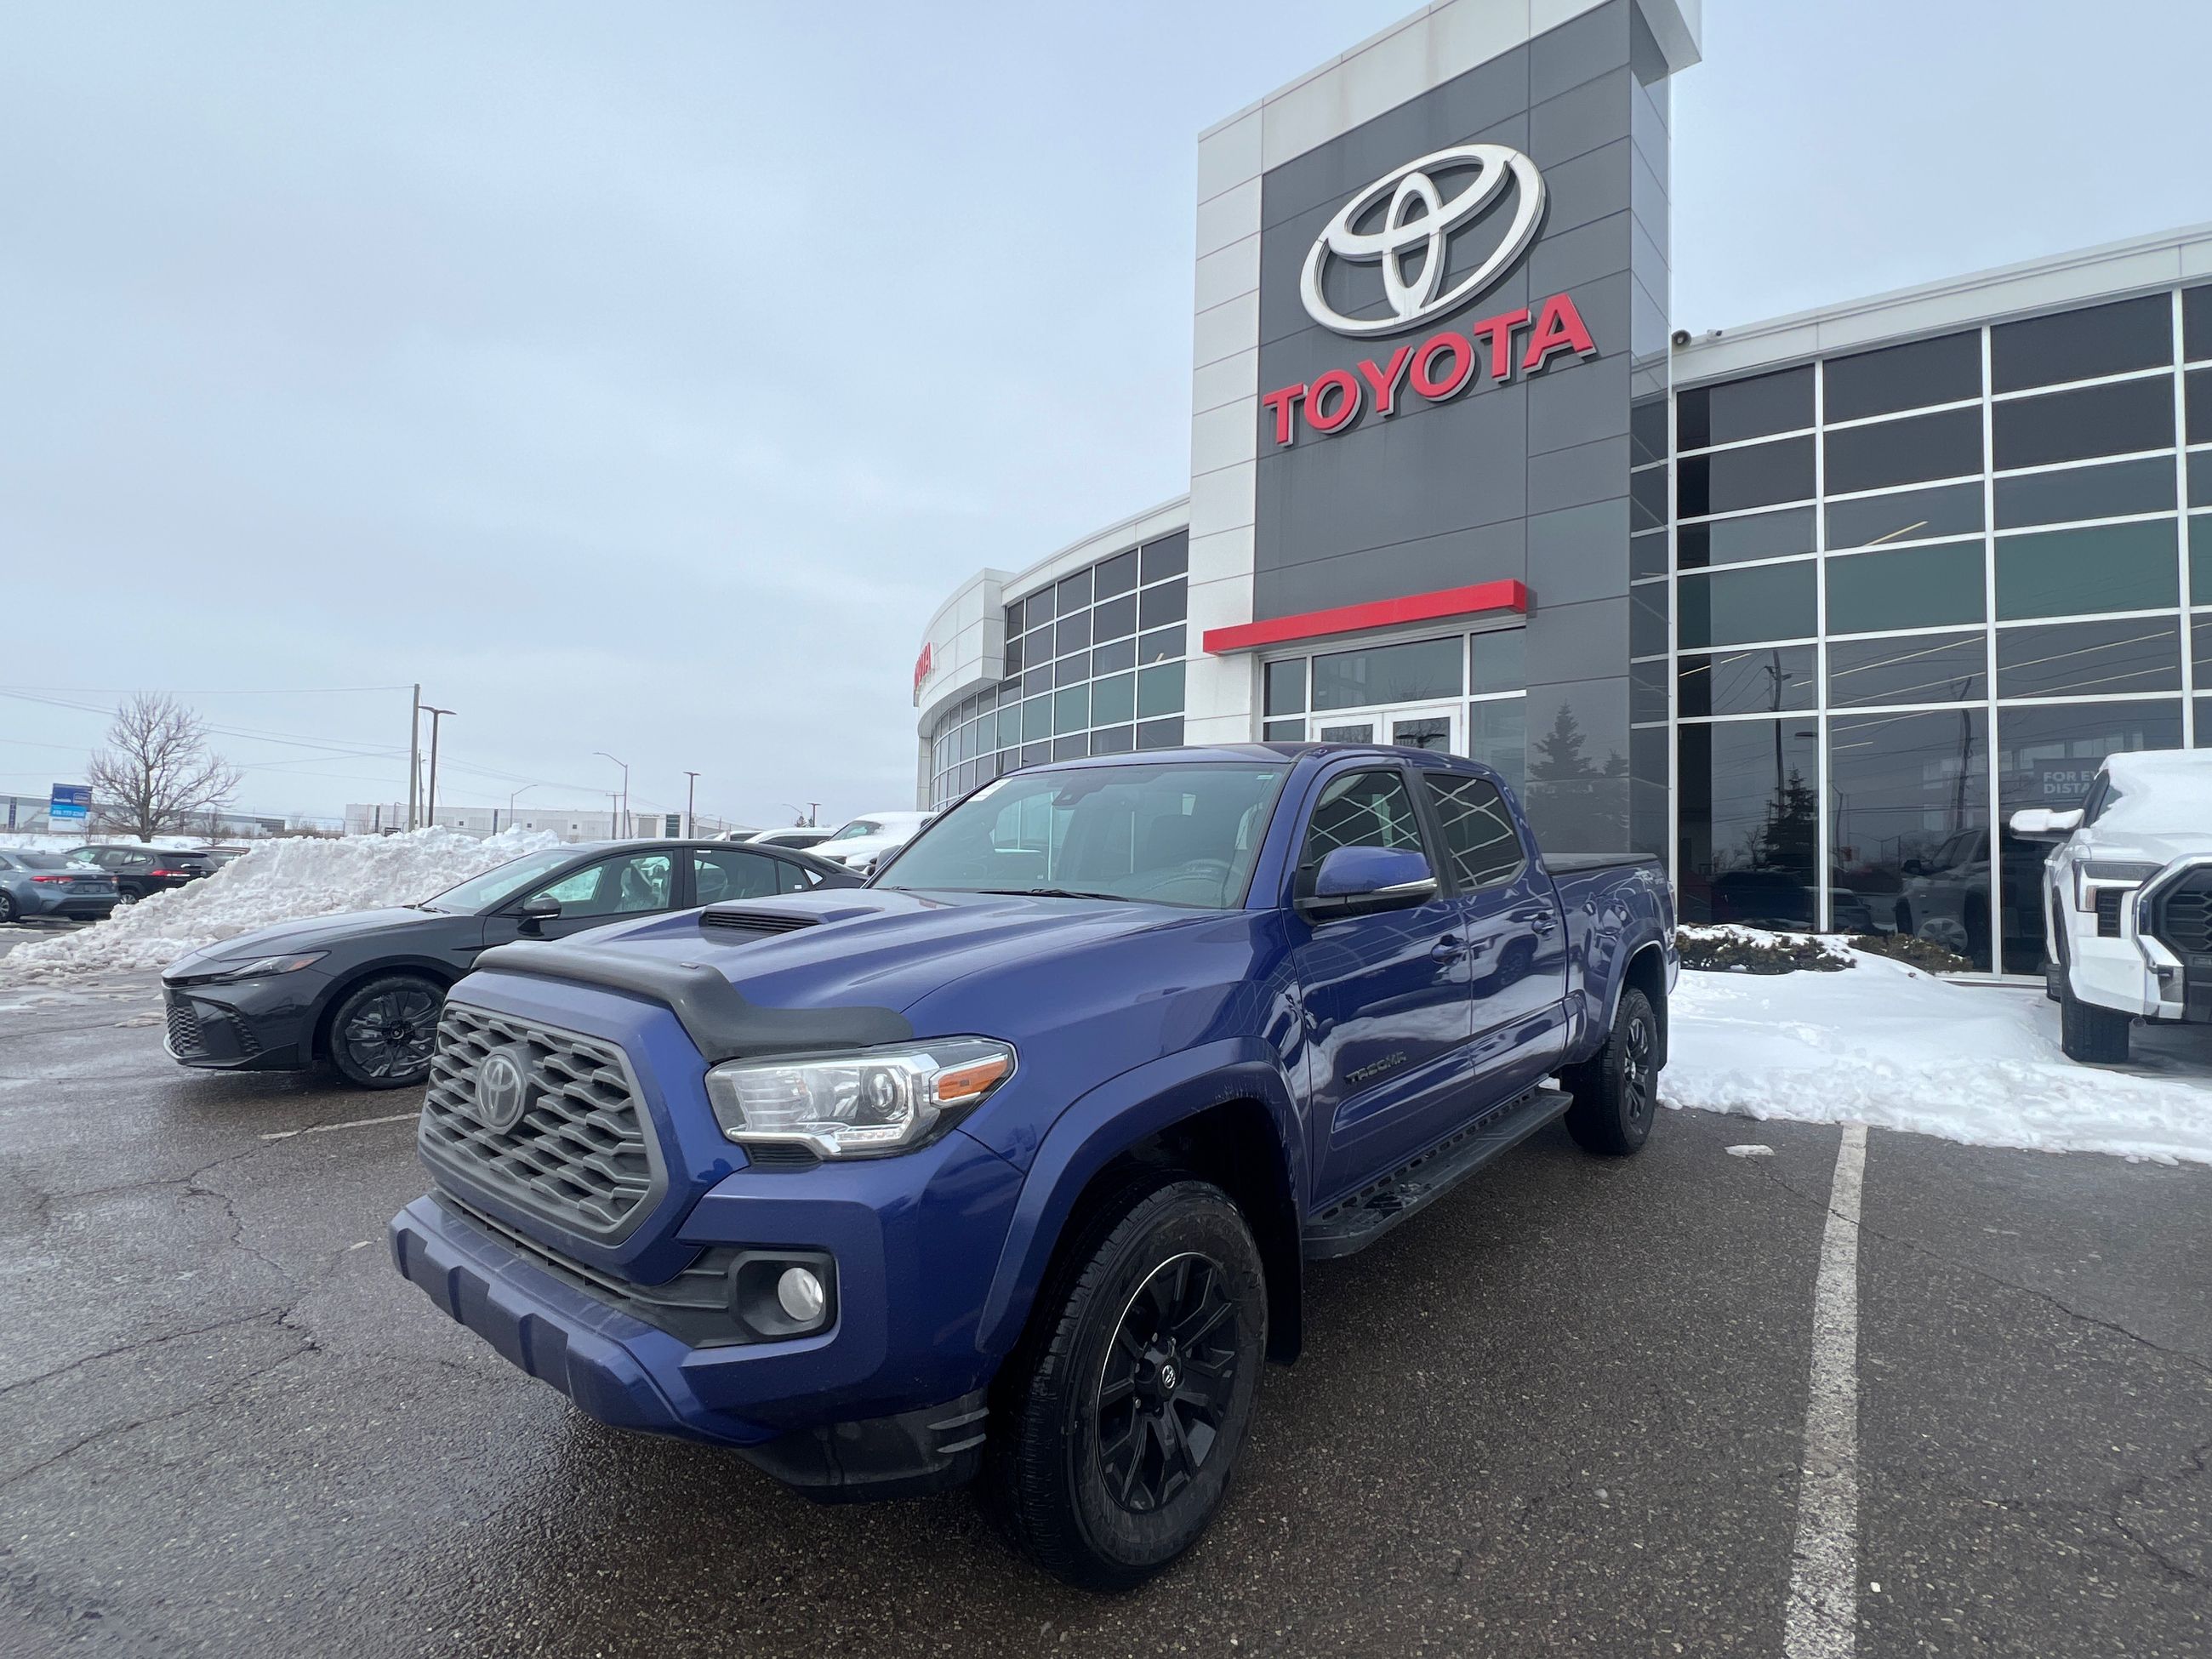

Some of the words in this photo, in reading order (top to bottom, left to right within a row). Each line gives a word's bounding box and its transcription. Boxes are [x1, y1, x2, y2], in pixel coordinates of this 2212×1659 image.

[1263, 293, 1595, 446] TOYOTA
[2044, 771, 2076, 782] FOR
[1345, 1052, 1406, 1082] TACOMA
